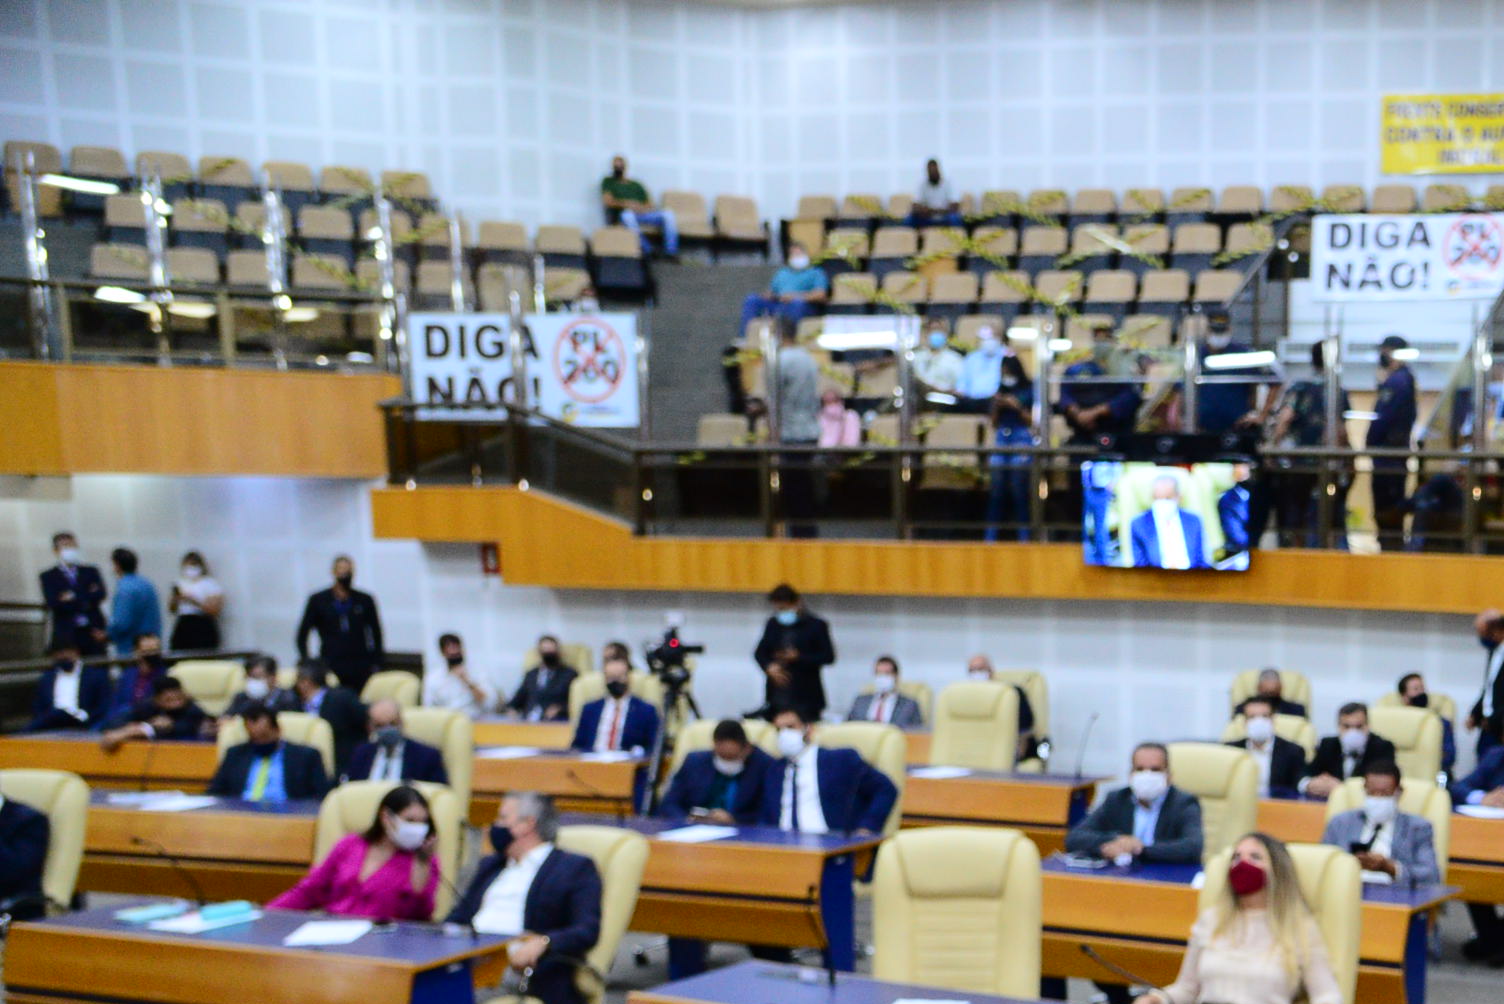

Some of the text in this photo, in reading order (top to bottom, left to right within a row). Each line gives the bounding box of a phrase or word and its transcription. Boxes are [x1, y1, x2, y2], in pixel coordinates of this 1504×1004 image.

[1329, 221, 1431, 250] DIGA
[1326, 255, 1430, 290] NÃO!
[425, 325, 540, 359] DIGA
